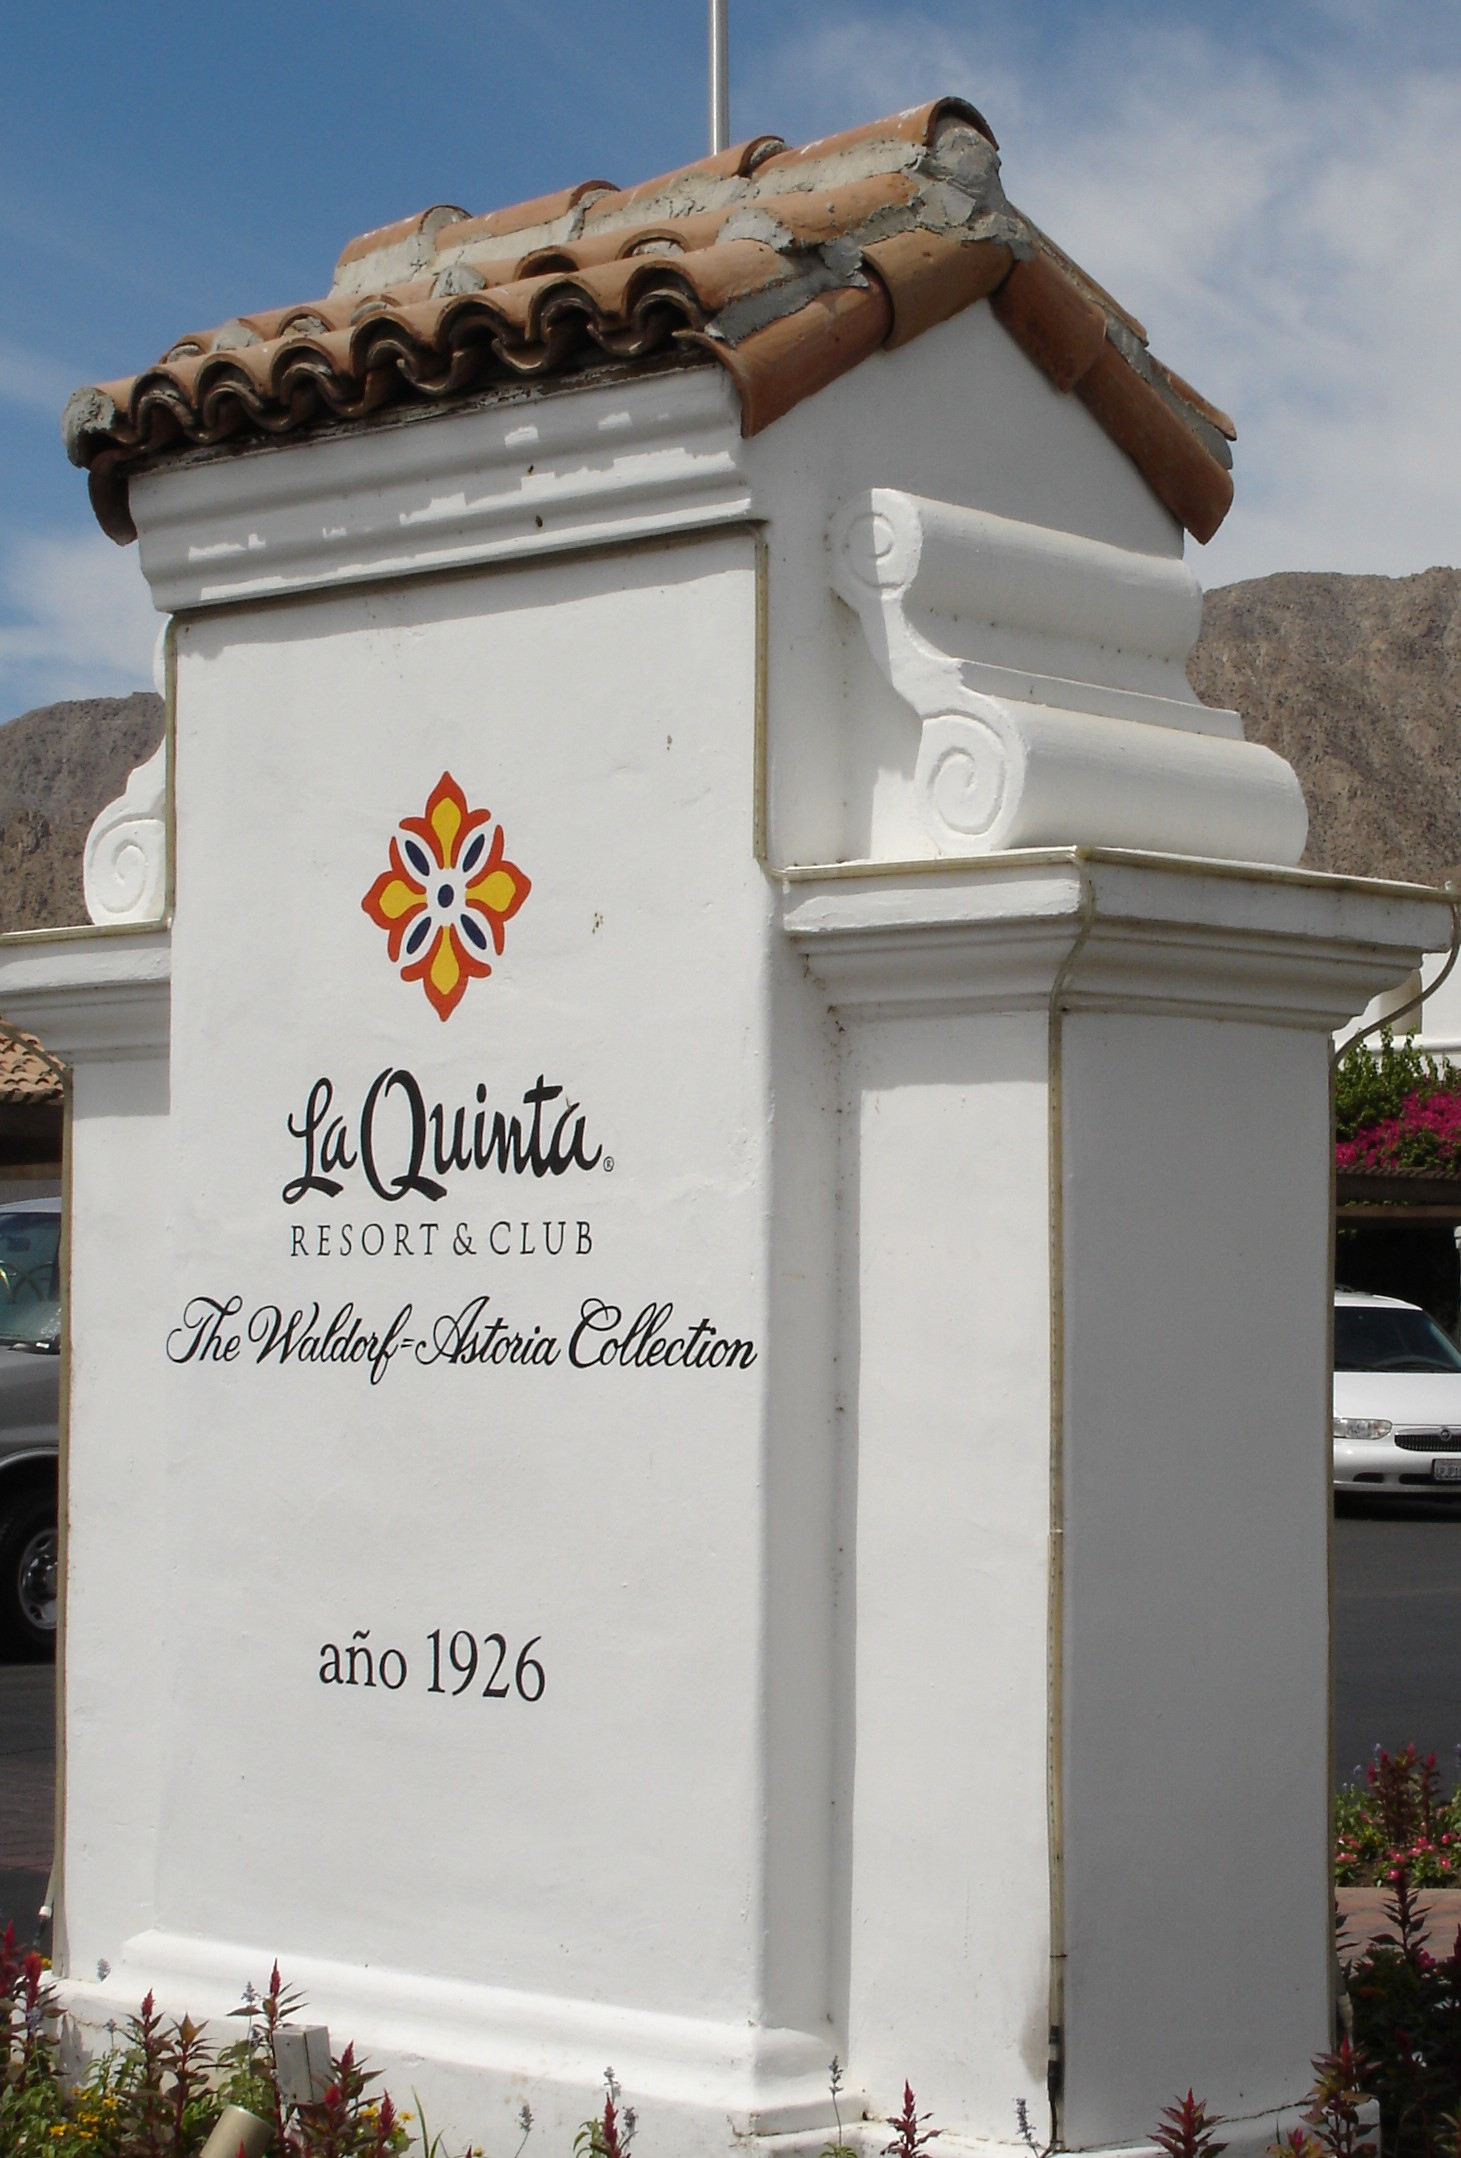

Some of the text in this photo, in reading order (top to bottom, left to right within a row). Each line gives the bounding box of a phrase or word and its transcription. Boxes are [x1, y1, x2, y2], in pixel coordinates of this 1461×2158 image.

[283, 1077, 358, 1205] La
[290, 1221, 593, 1257] RESORT & CLUB
[167, 1296, 243, 1364] The
[569, 1297, 758, 1370] Collection
[319, 1628, 546, 1702] año 1926
